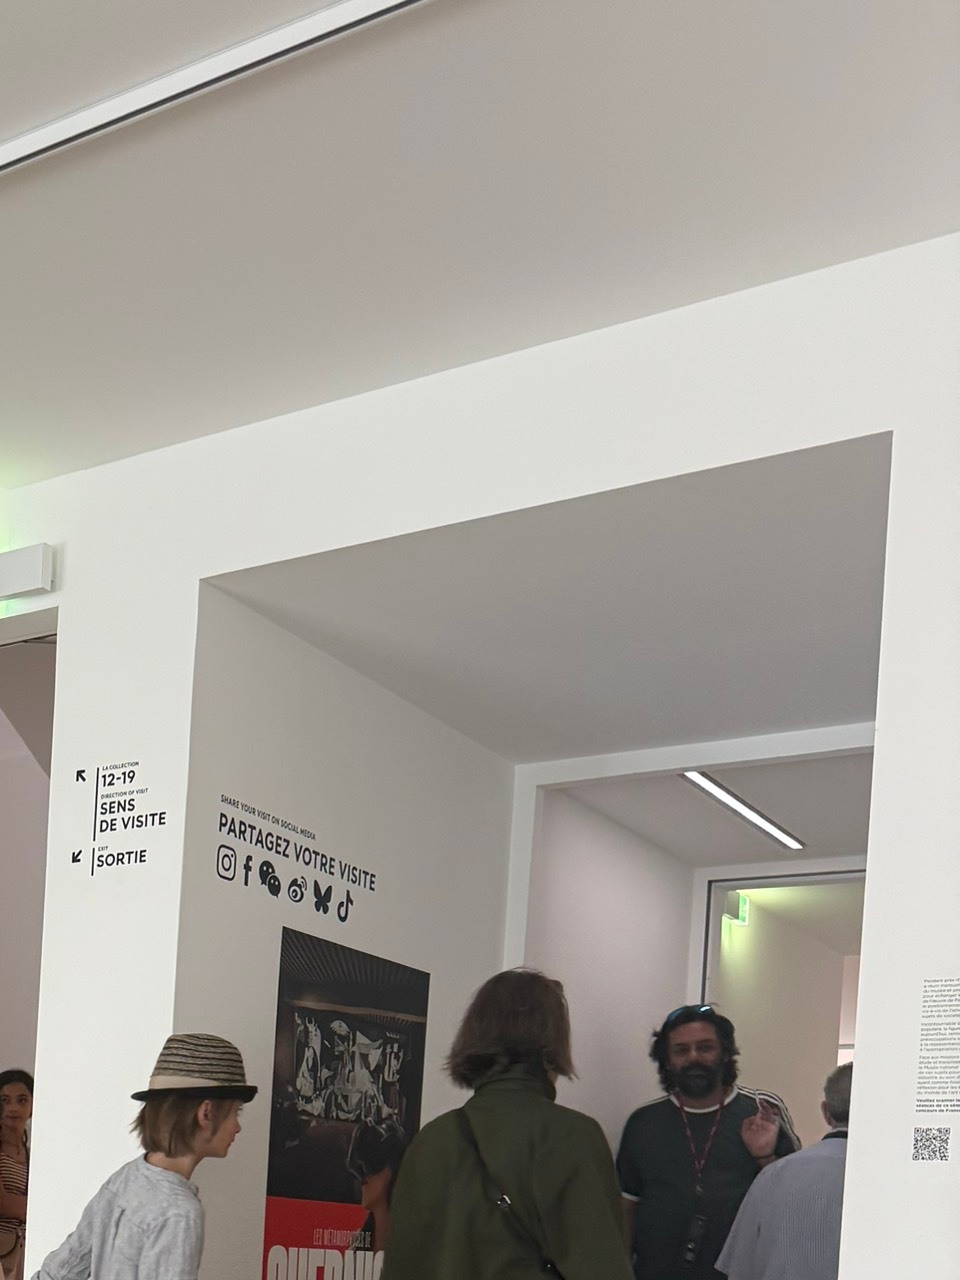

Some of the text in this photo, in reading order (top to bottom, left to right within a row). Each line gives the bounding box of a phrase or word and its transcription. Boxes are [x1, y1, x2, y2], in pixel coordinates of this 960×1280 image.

[109, 761, 139, 770] COLLECTION
[101, 770, 136, 787] 12-19
[100, 791, 127, 799] DIRECTION
[135, 787, 149, 795] VISIT
[100, 798, 135, 815] SENS
[100, 811, 166, 833] DE VISITE
[220, 794, 316, 841] SHARE YOUR VISIT ON SOCIAL MEDIA
[97, 849, 147, 868] SORTIE
[219, 812, 376, 892] PARTAGEZ VOTRE VISITE
